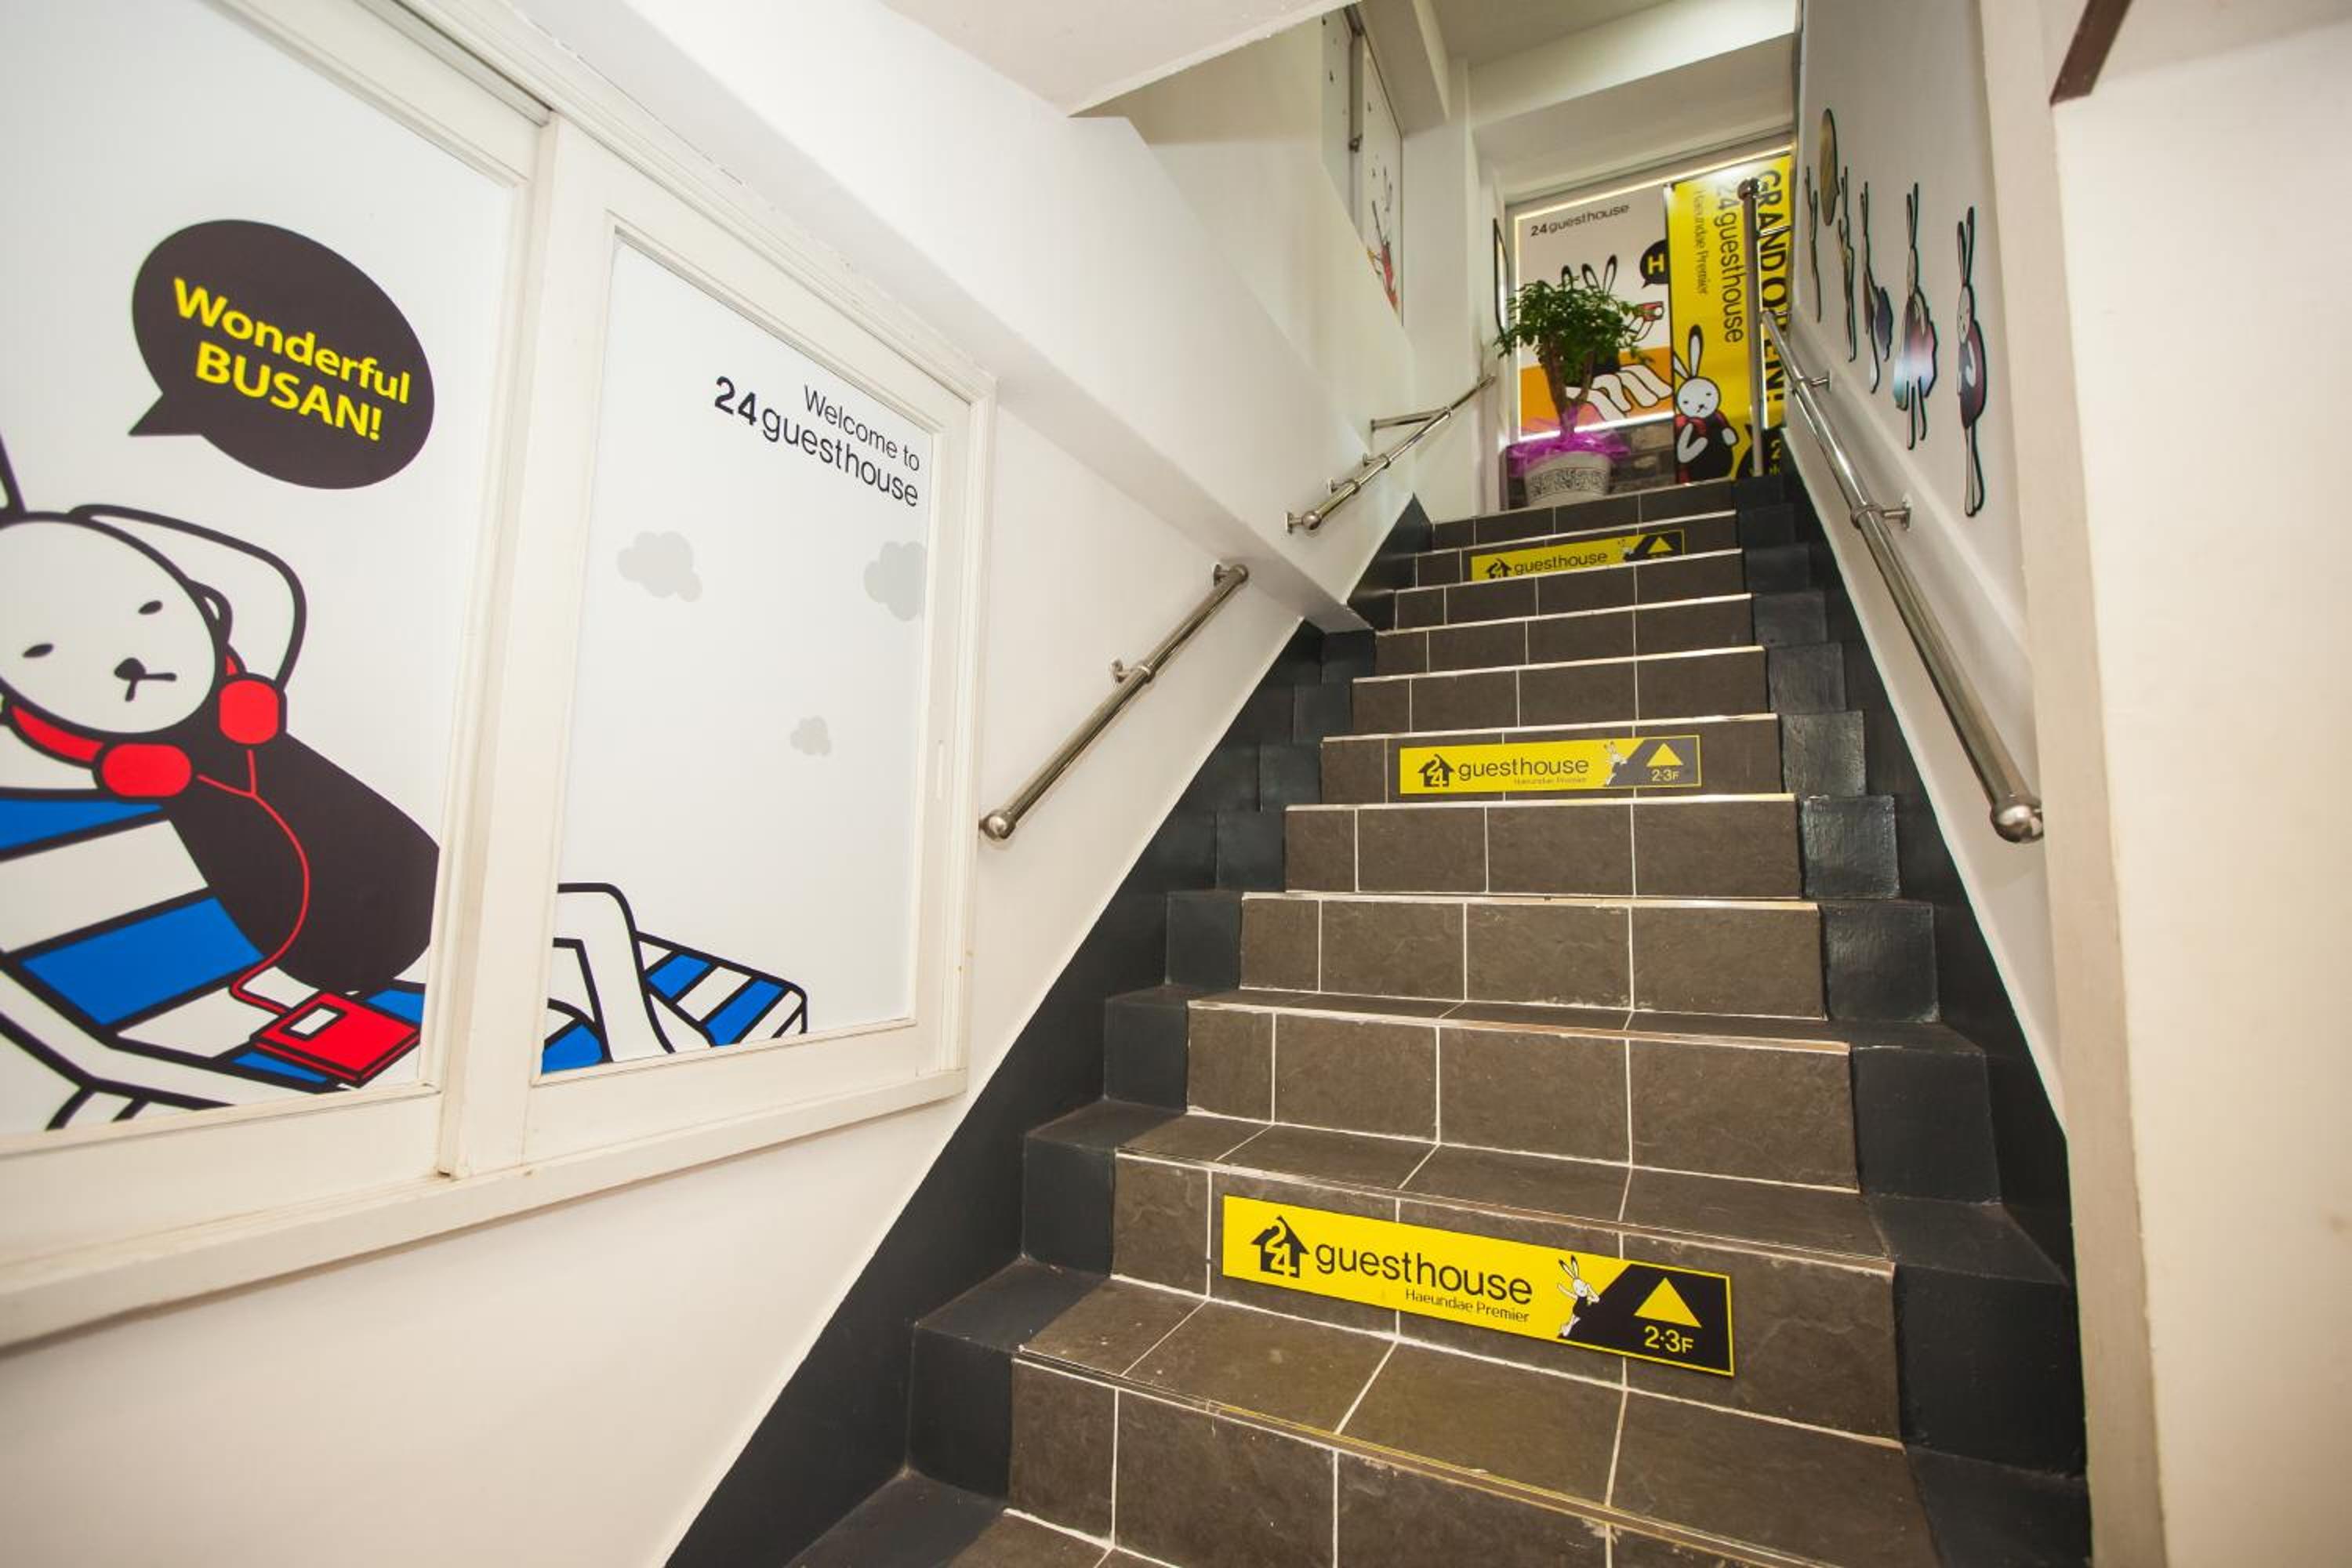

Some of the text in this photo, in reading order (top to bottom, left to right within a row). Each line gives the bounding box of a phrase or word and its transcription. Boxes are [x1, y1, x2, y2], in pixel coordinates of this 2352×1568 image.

[173, 277, 411, 404] Wonderful
[195, 340, 383, 441] BUSAN!
[804, 383, 920, 472] Welcome to
[1514, 550, 1609, 575] guesthouse
[1457, 756, 1589, 781] guesthouse
[1315, 1243, 1534, 1305] guesthouse
[1405, 1288, 1531, 1323] Haeundae Premier
